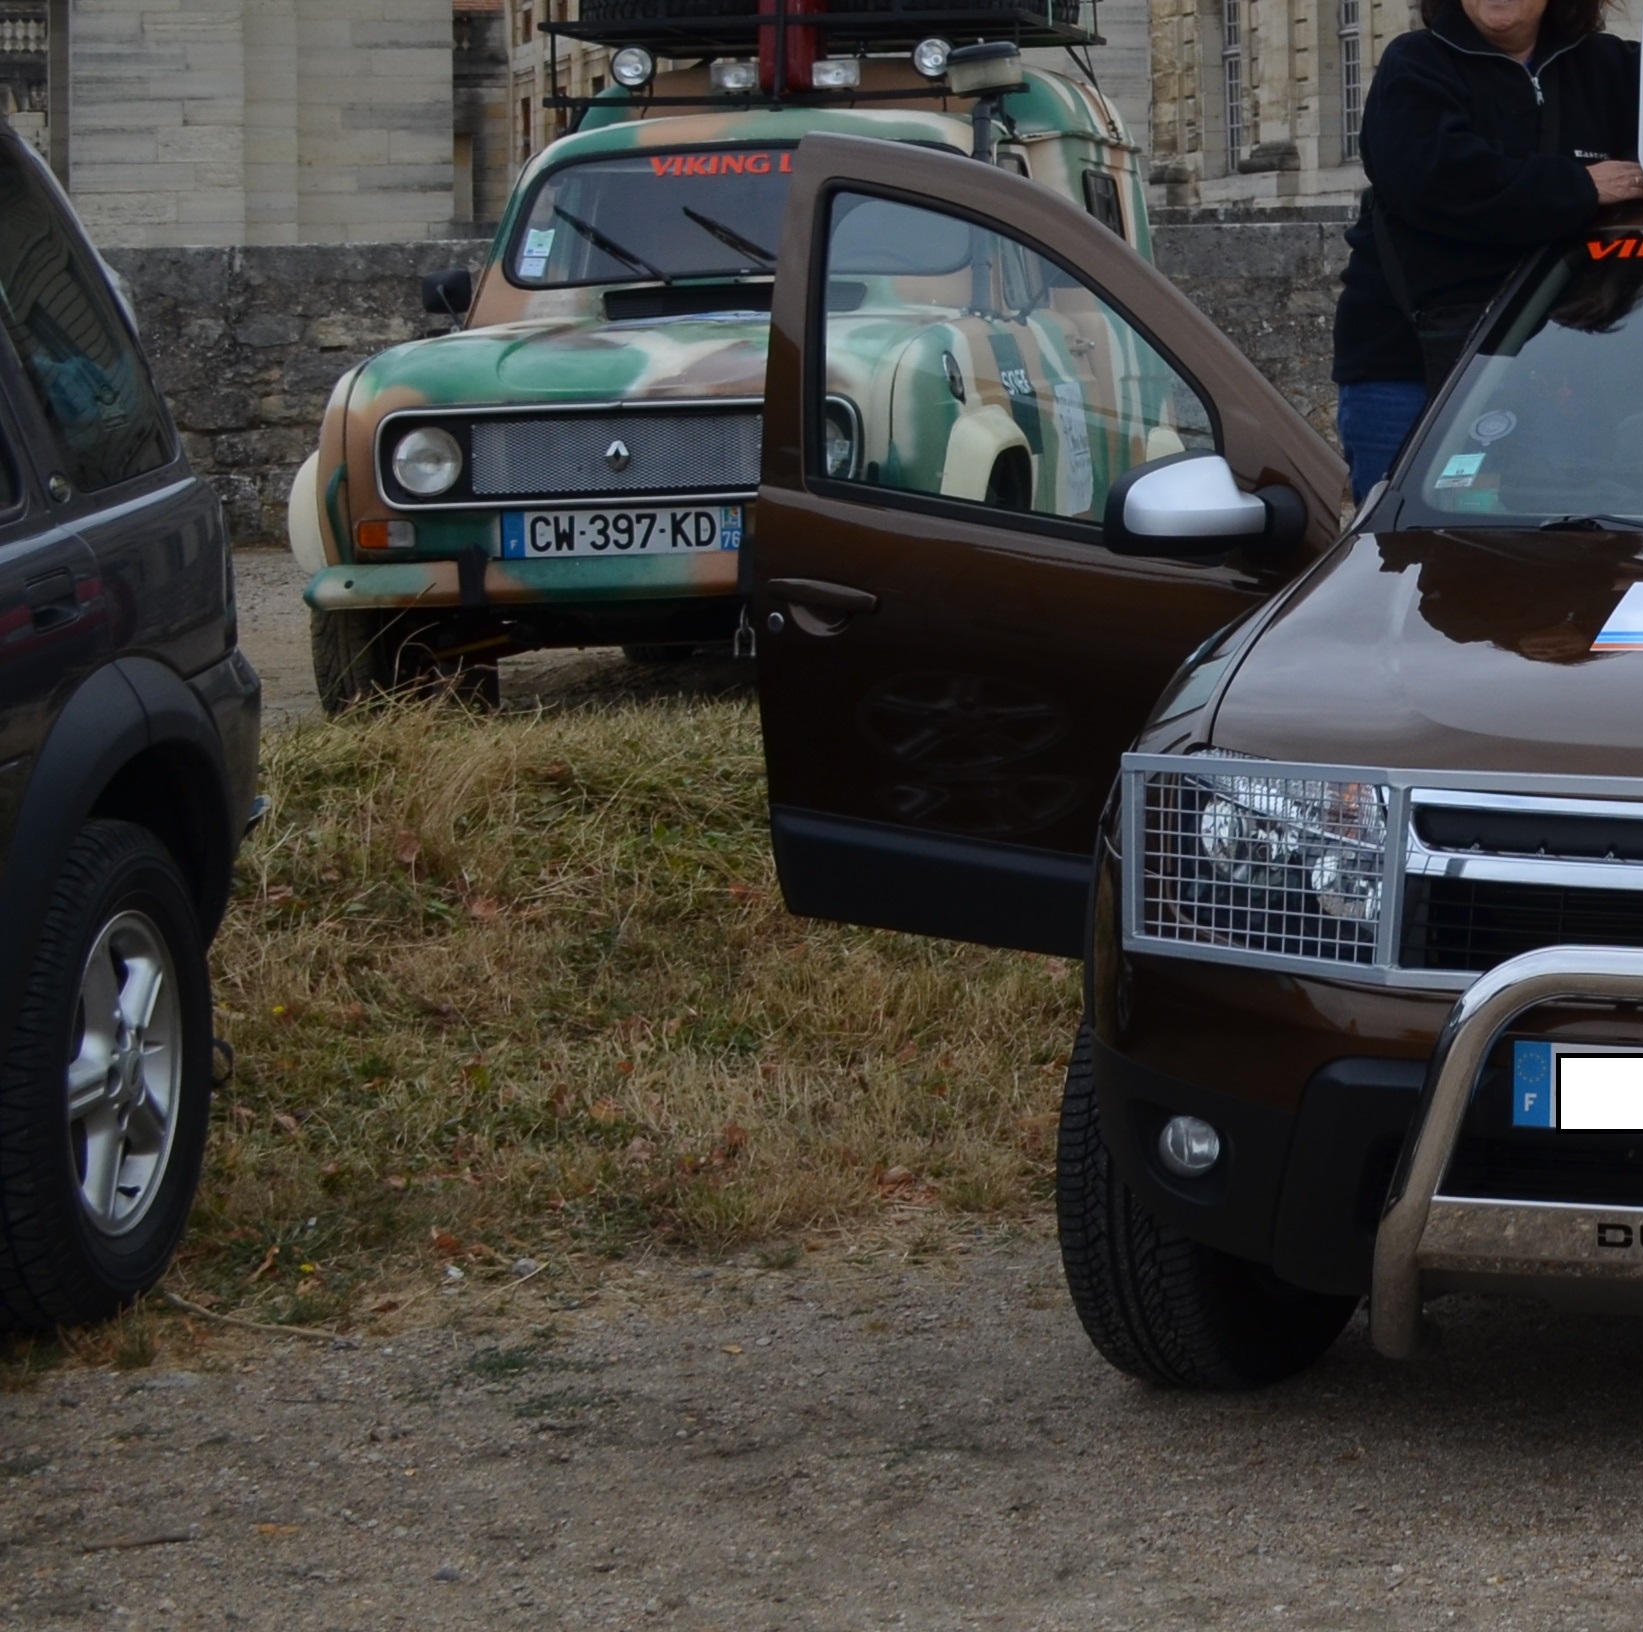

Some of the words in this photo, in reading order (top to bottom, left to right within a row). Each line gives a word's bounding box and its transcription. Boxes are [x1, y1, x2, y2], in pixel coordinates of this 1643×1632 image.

[649, 152, 772, 177] VIKING
[529, 510, 717, 553] CW-397-KD
[721, 530, 742, 549] 76
[1523, 1092, 1537, 1112] F
